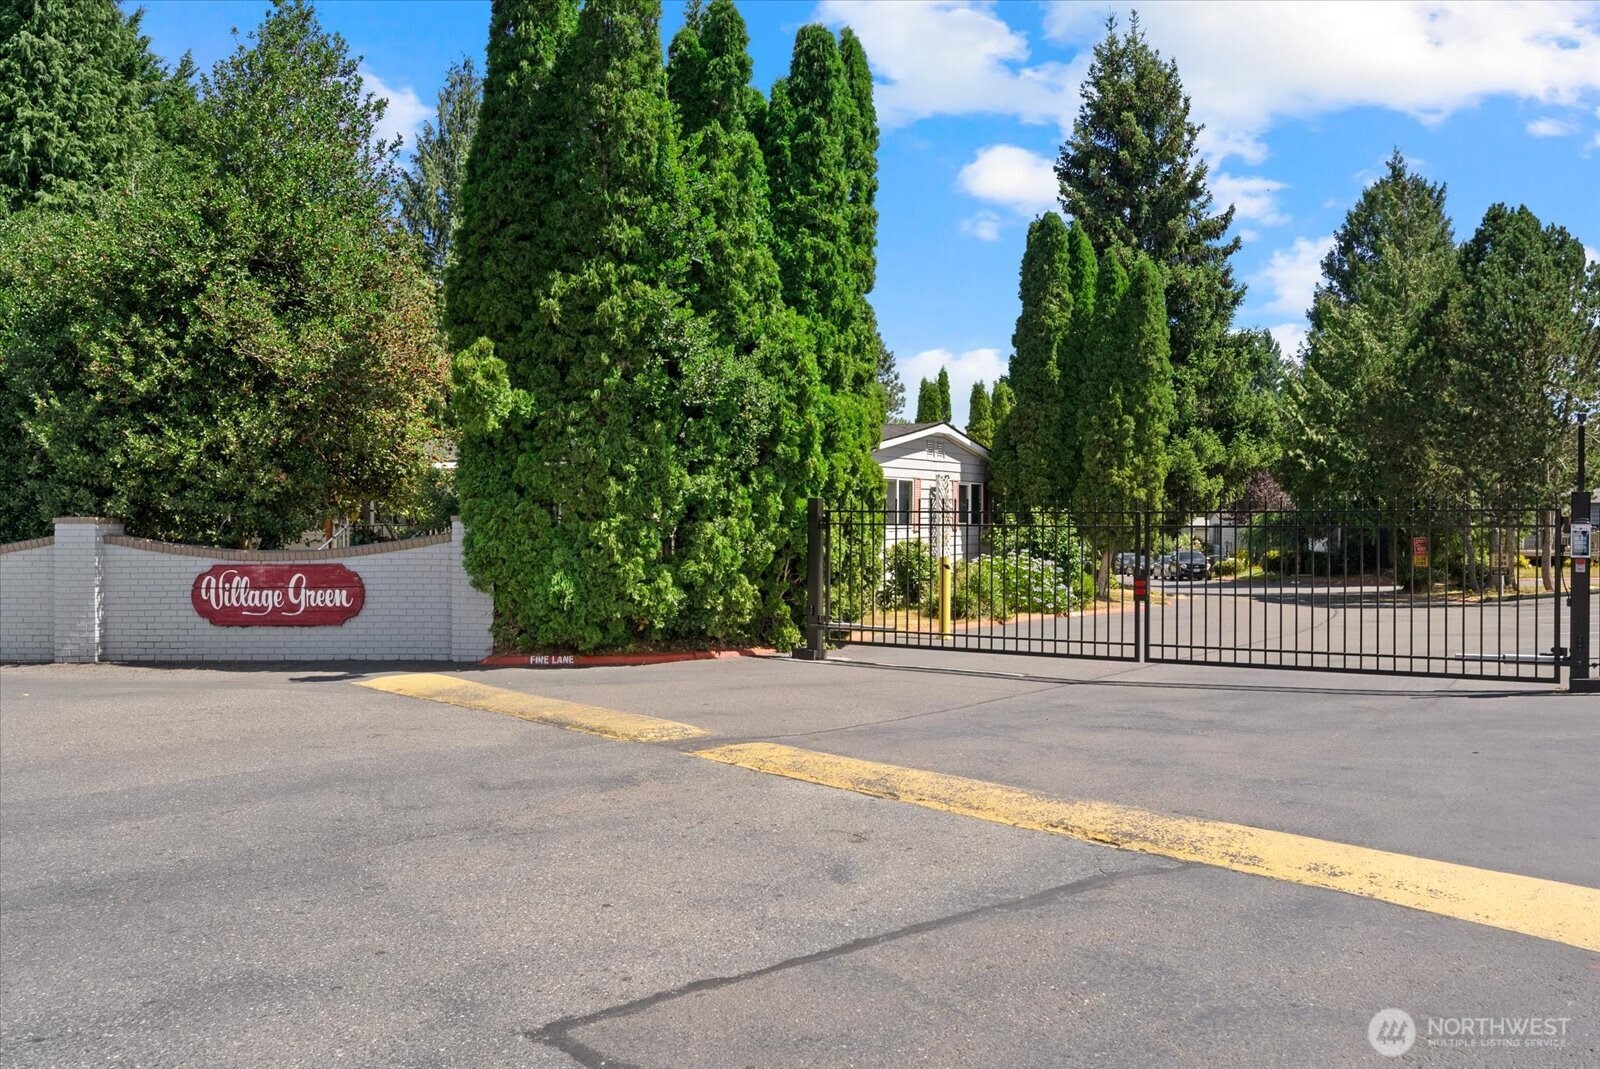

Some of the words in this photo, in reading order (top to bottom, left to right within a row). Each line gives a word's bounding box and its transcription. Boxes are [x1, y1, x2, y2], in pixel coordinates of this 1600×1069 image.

[201, 570, 284, 615] Village
[282, 573, 353, 615] Green
[530, 655, 549, 665] FIRE
[551, 655, 574, 664] LANE
